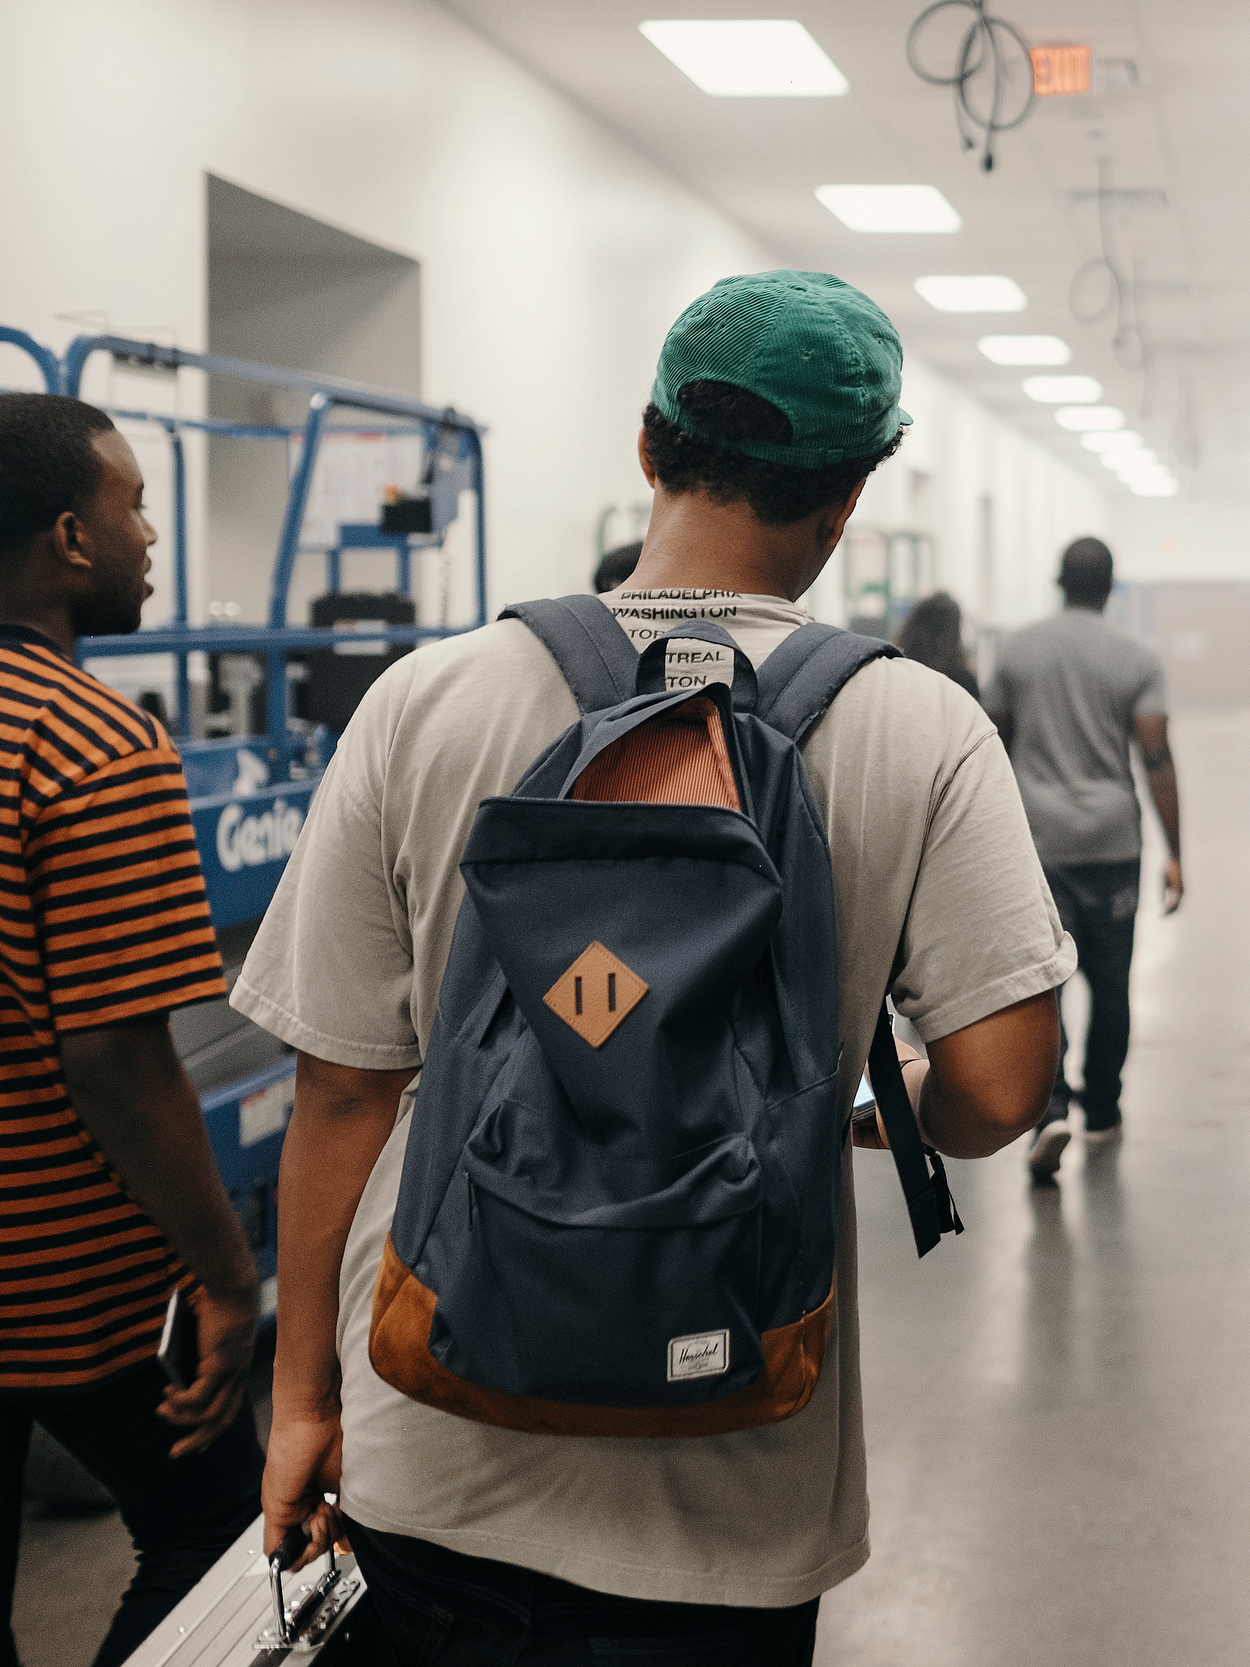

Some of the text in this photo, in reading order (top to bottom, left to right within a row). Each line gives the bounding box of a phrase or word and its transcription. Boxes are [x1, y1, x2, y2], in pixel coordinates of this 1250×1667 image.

[1030, 46, 1091, 96] EXIT
[620, 588, 742, 601] PHILADELPHIA
[612, 605, 738, 620] WASHINGTON
[666, 651, 726, 664] TREAL
[667, 675, 708, 688] TON
[216, 798, 304, 872] Genie
[679, 1342, 719, 1365] Herschel
